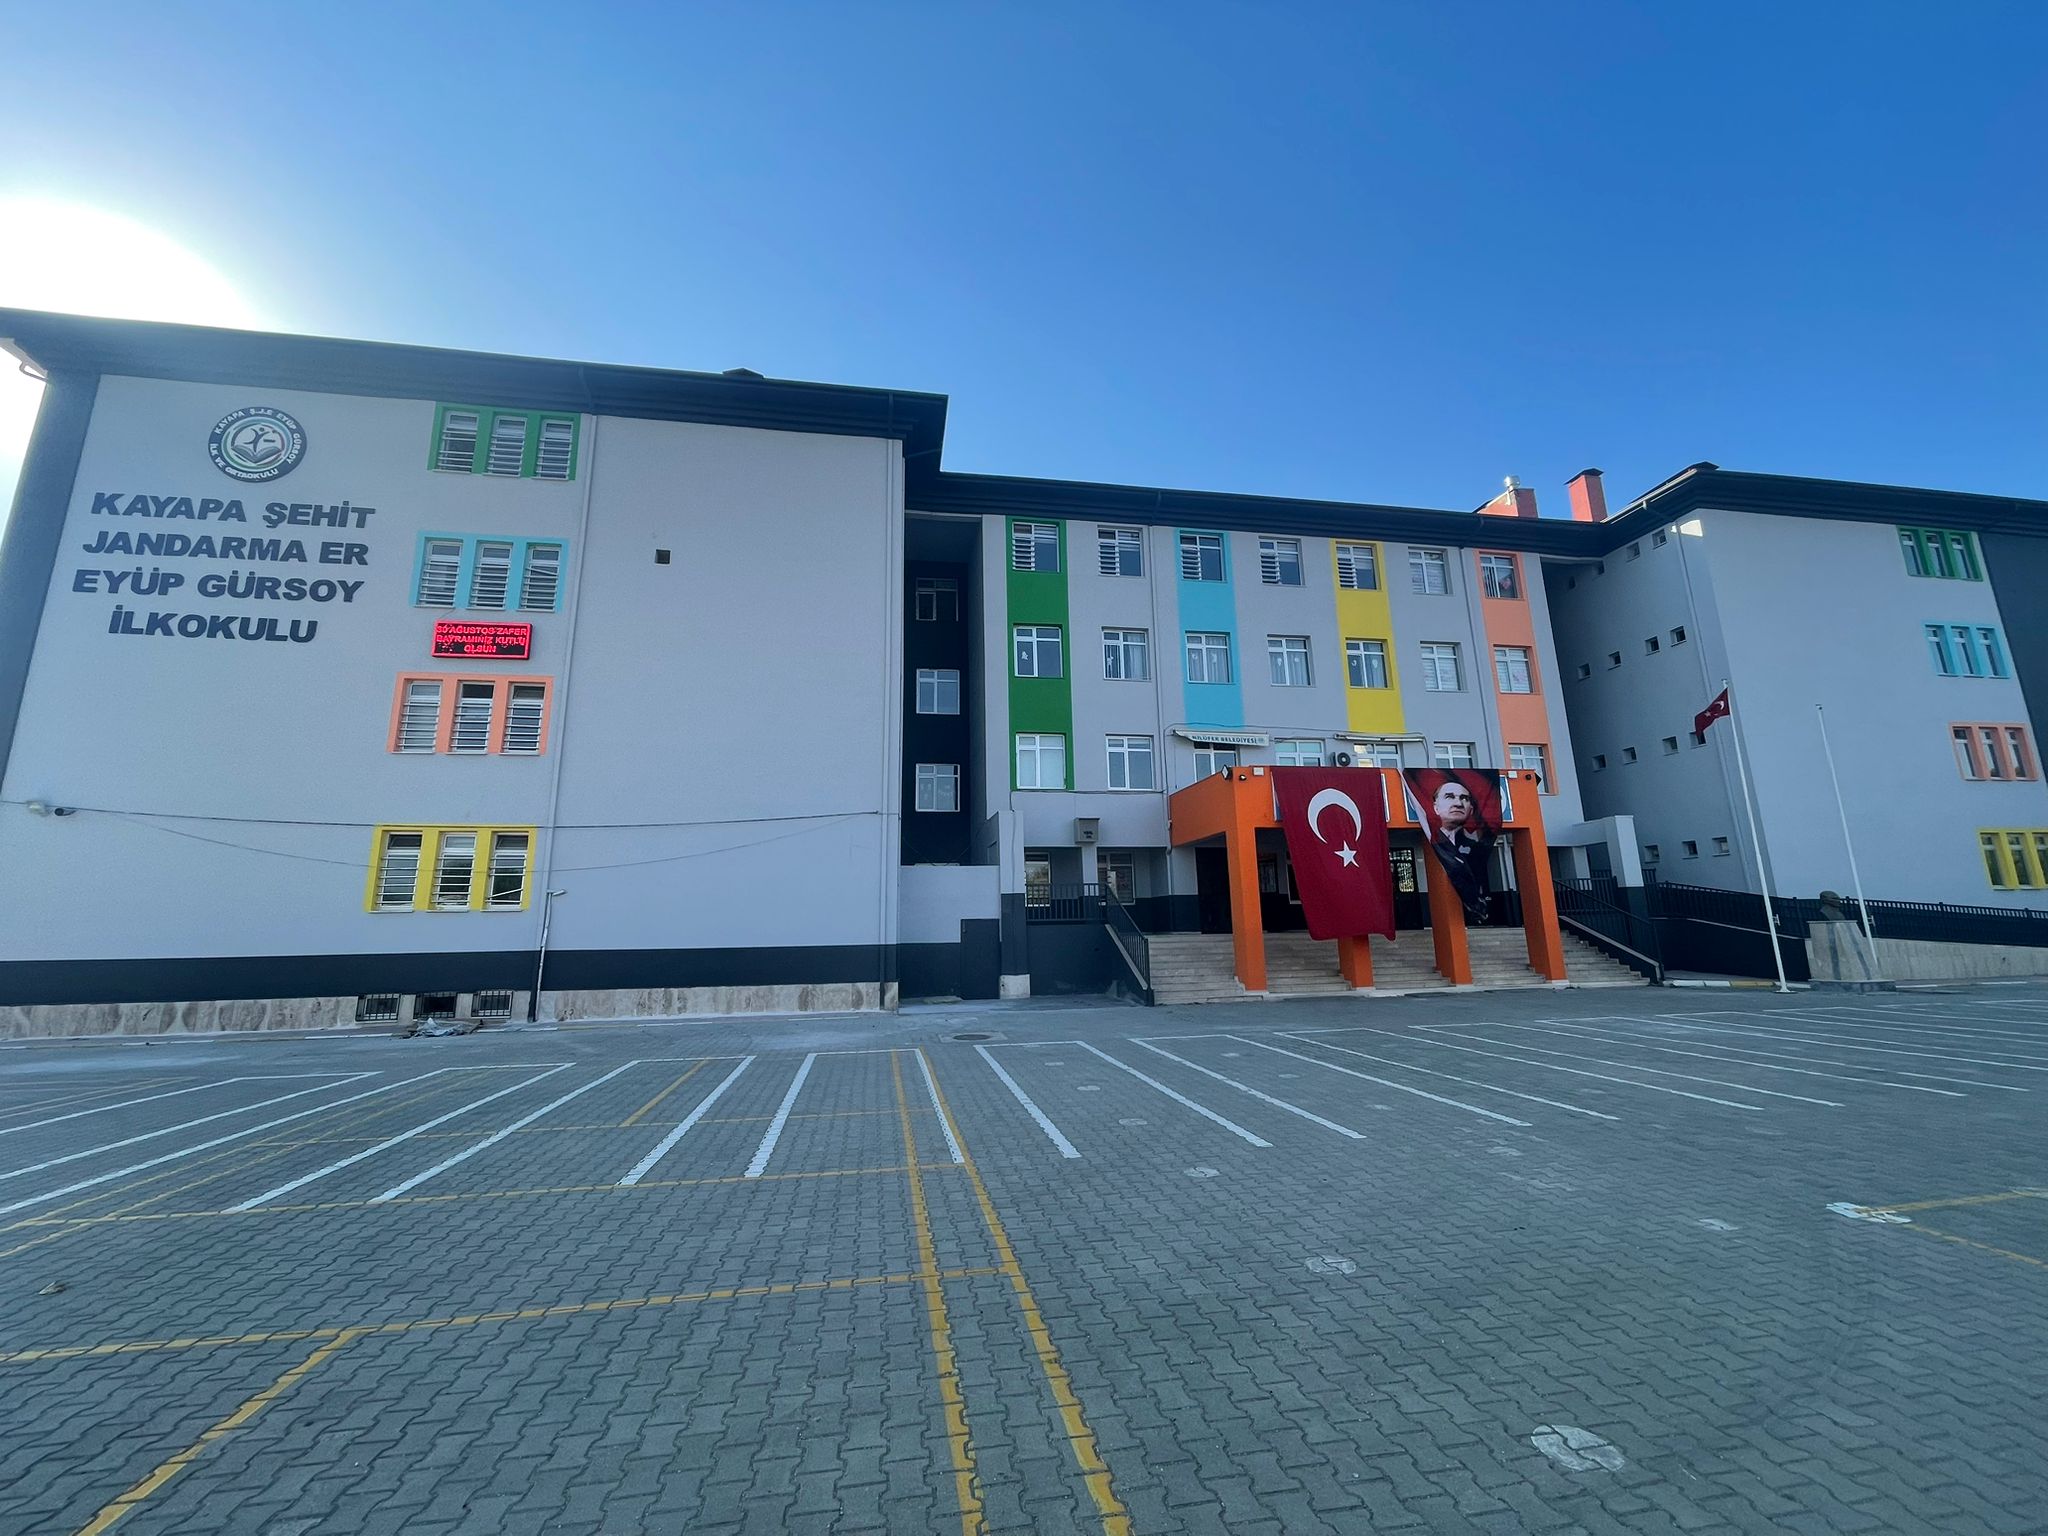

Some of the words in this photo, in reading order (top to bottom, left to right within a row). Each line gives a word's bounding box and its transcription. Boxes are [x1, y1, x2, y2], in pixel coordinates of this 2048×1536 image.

[214, 410, 245, 434] KAYAPA
[276, 412, 297, 430] EYÜP
[286, 433, 303, 464] GÜRSOY
[214, 456, 226, 468] VE
[225, 467, 280, 479] ORTAOKULU
[91, 492, 247, 522] KAYAPA
[262, 501, 376, 529] ŞEHİT
[82, 531, 308, 563] JANDARMA
[319, 541, 369, 566] ER
[72, 566, 185, 596] EYÜP
[197, 570, 365, 603] GÜRSOY
[108, 604, 319, 643] İLKOKULU
[496, 627, 528, 636] ZAFER
[463, 644, 497, 653] OLSUN
[495, 636, 526, 646] KUTLU
